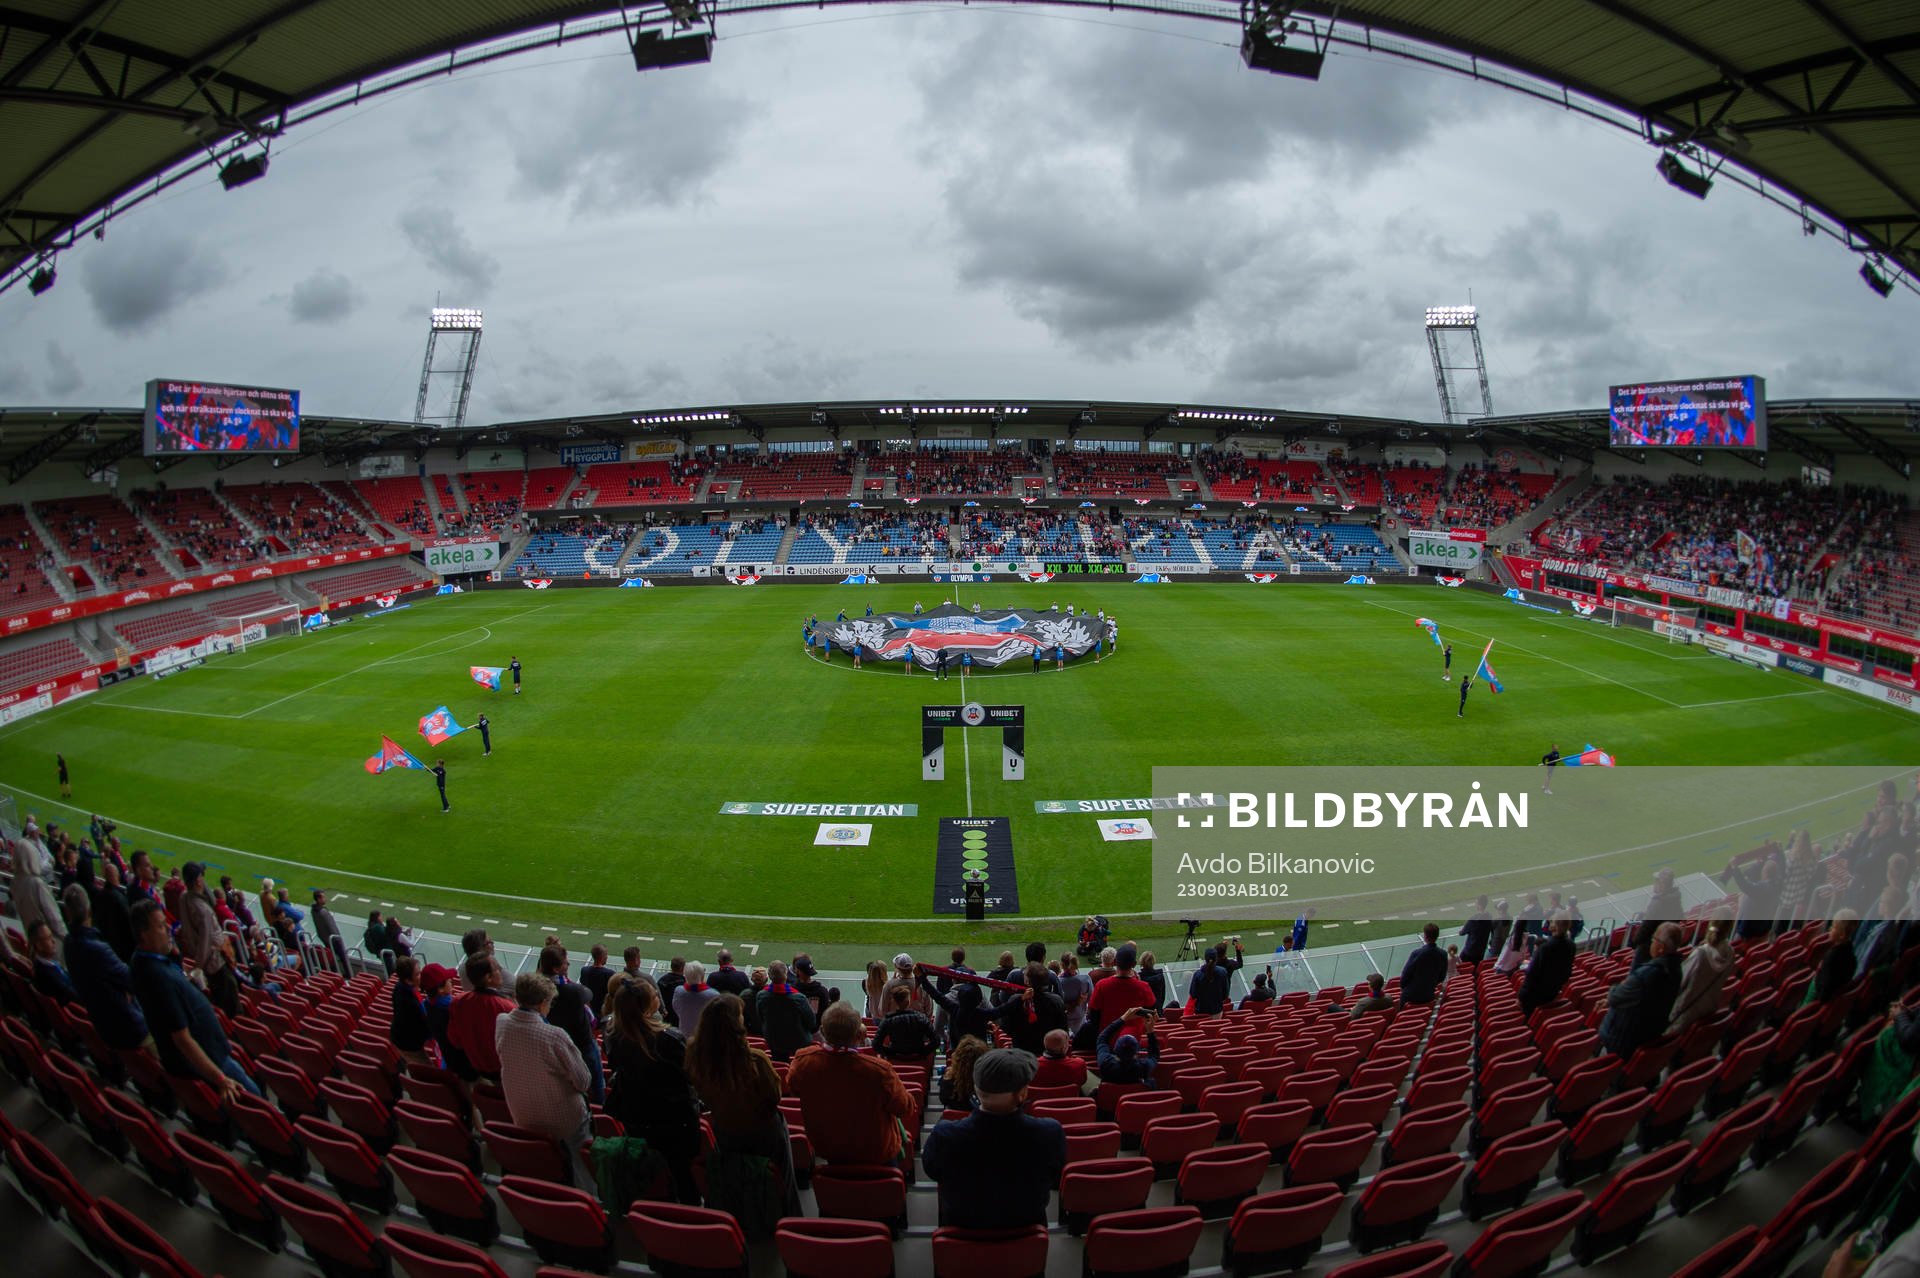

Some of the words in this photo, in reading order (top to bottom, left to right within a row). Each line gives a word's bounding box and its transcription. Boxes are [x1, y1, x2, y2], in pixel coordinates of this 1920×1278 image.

[168, 383, 182, 393] Det
[248, 388, 259, 398] och
[1618, 387, 1629, 396] Det
[1692, 383, 1704, 391] och
[161, 405, 175, 413] och
[1614, 405, 1625, 413] och
[1718, 401, 1729, 409] ska
[433, 539, 456, 547] Scandic
[468, 535, 491, 544] Scandic
[1414, 540, 1458, 558] akea
[430, 548, 475, 566] akea
[800, 566, 865, 576] LINDÉNGRUPPEN
[868, 564, 877, 574] K
[898, 564, 906, 574] K
[927, 564, 936, 574] K
[1046, 564, 1063, 574] XXL
[1067, 564, 1083, 574] XXL
[950, 574, 973, 582] OLYMPIA
[990, 709, 1019, 717] UNIBET
[929, 758, 937, 768] U
[1009, 758, 1017, 768] U
[761, 803, 904, 816] SUPERETTAN
[950, 897, 1003, 905] UNET
